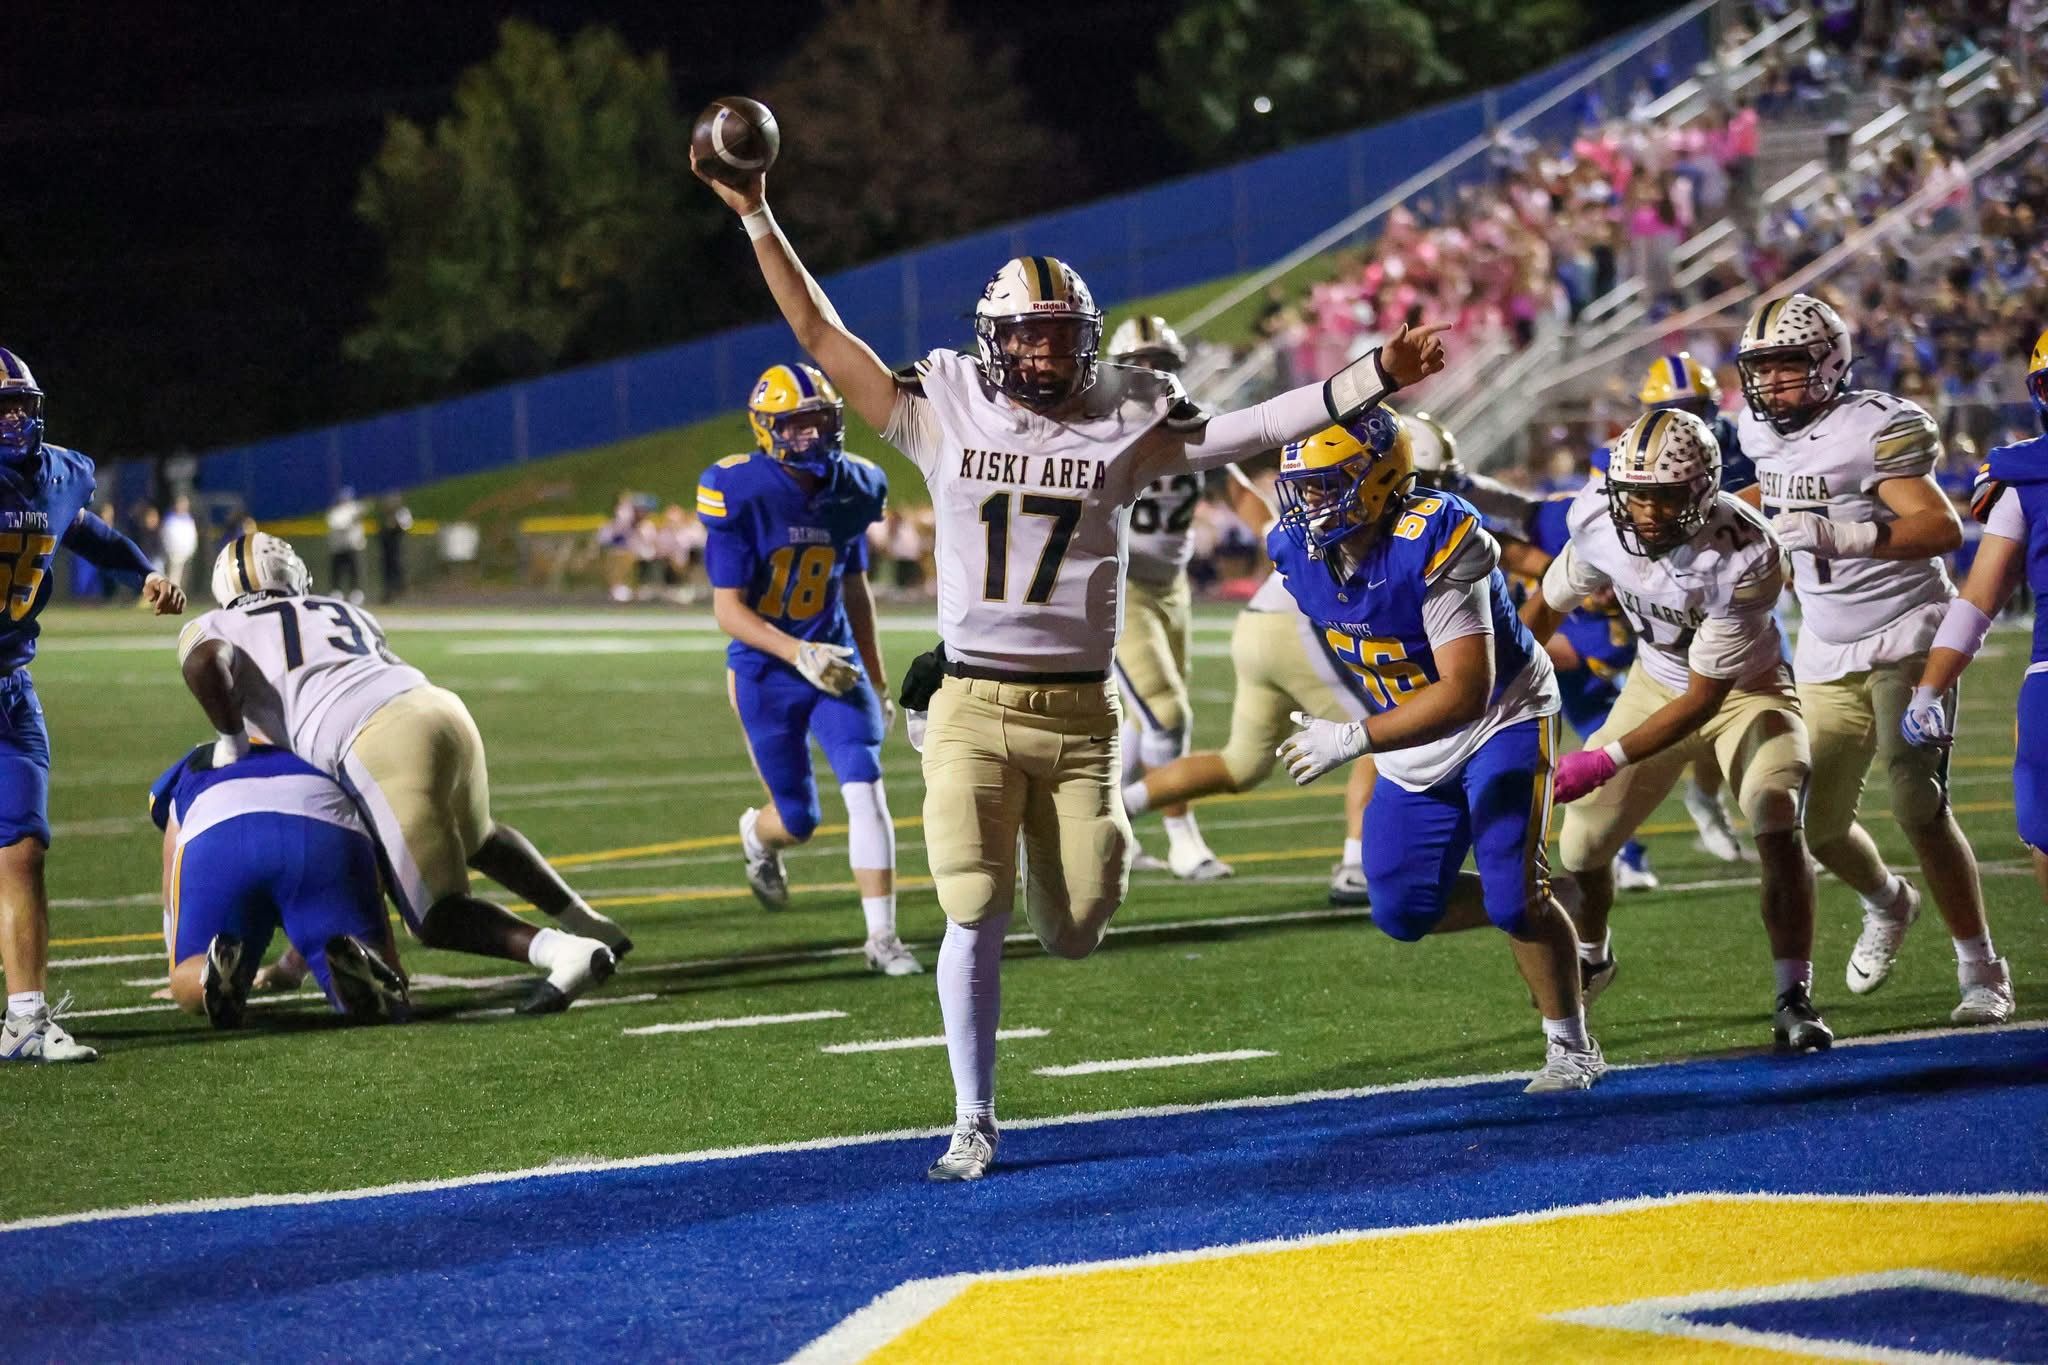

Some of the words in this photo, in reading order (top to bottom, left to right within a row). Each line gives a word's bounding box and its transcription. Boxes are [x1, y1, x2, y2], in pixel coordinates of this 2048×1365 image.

[959, 448, 1029, 485] KISKI
[1040, 457, 1106, 490] AREA
[1786, 475, 1833, 500] AREA
[757, 545, 836, 621] 18
[979, 490, 1084, 605] 17
[245, 600, 371, 672] 73
[1326, 628, 1432, 708] 56
